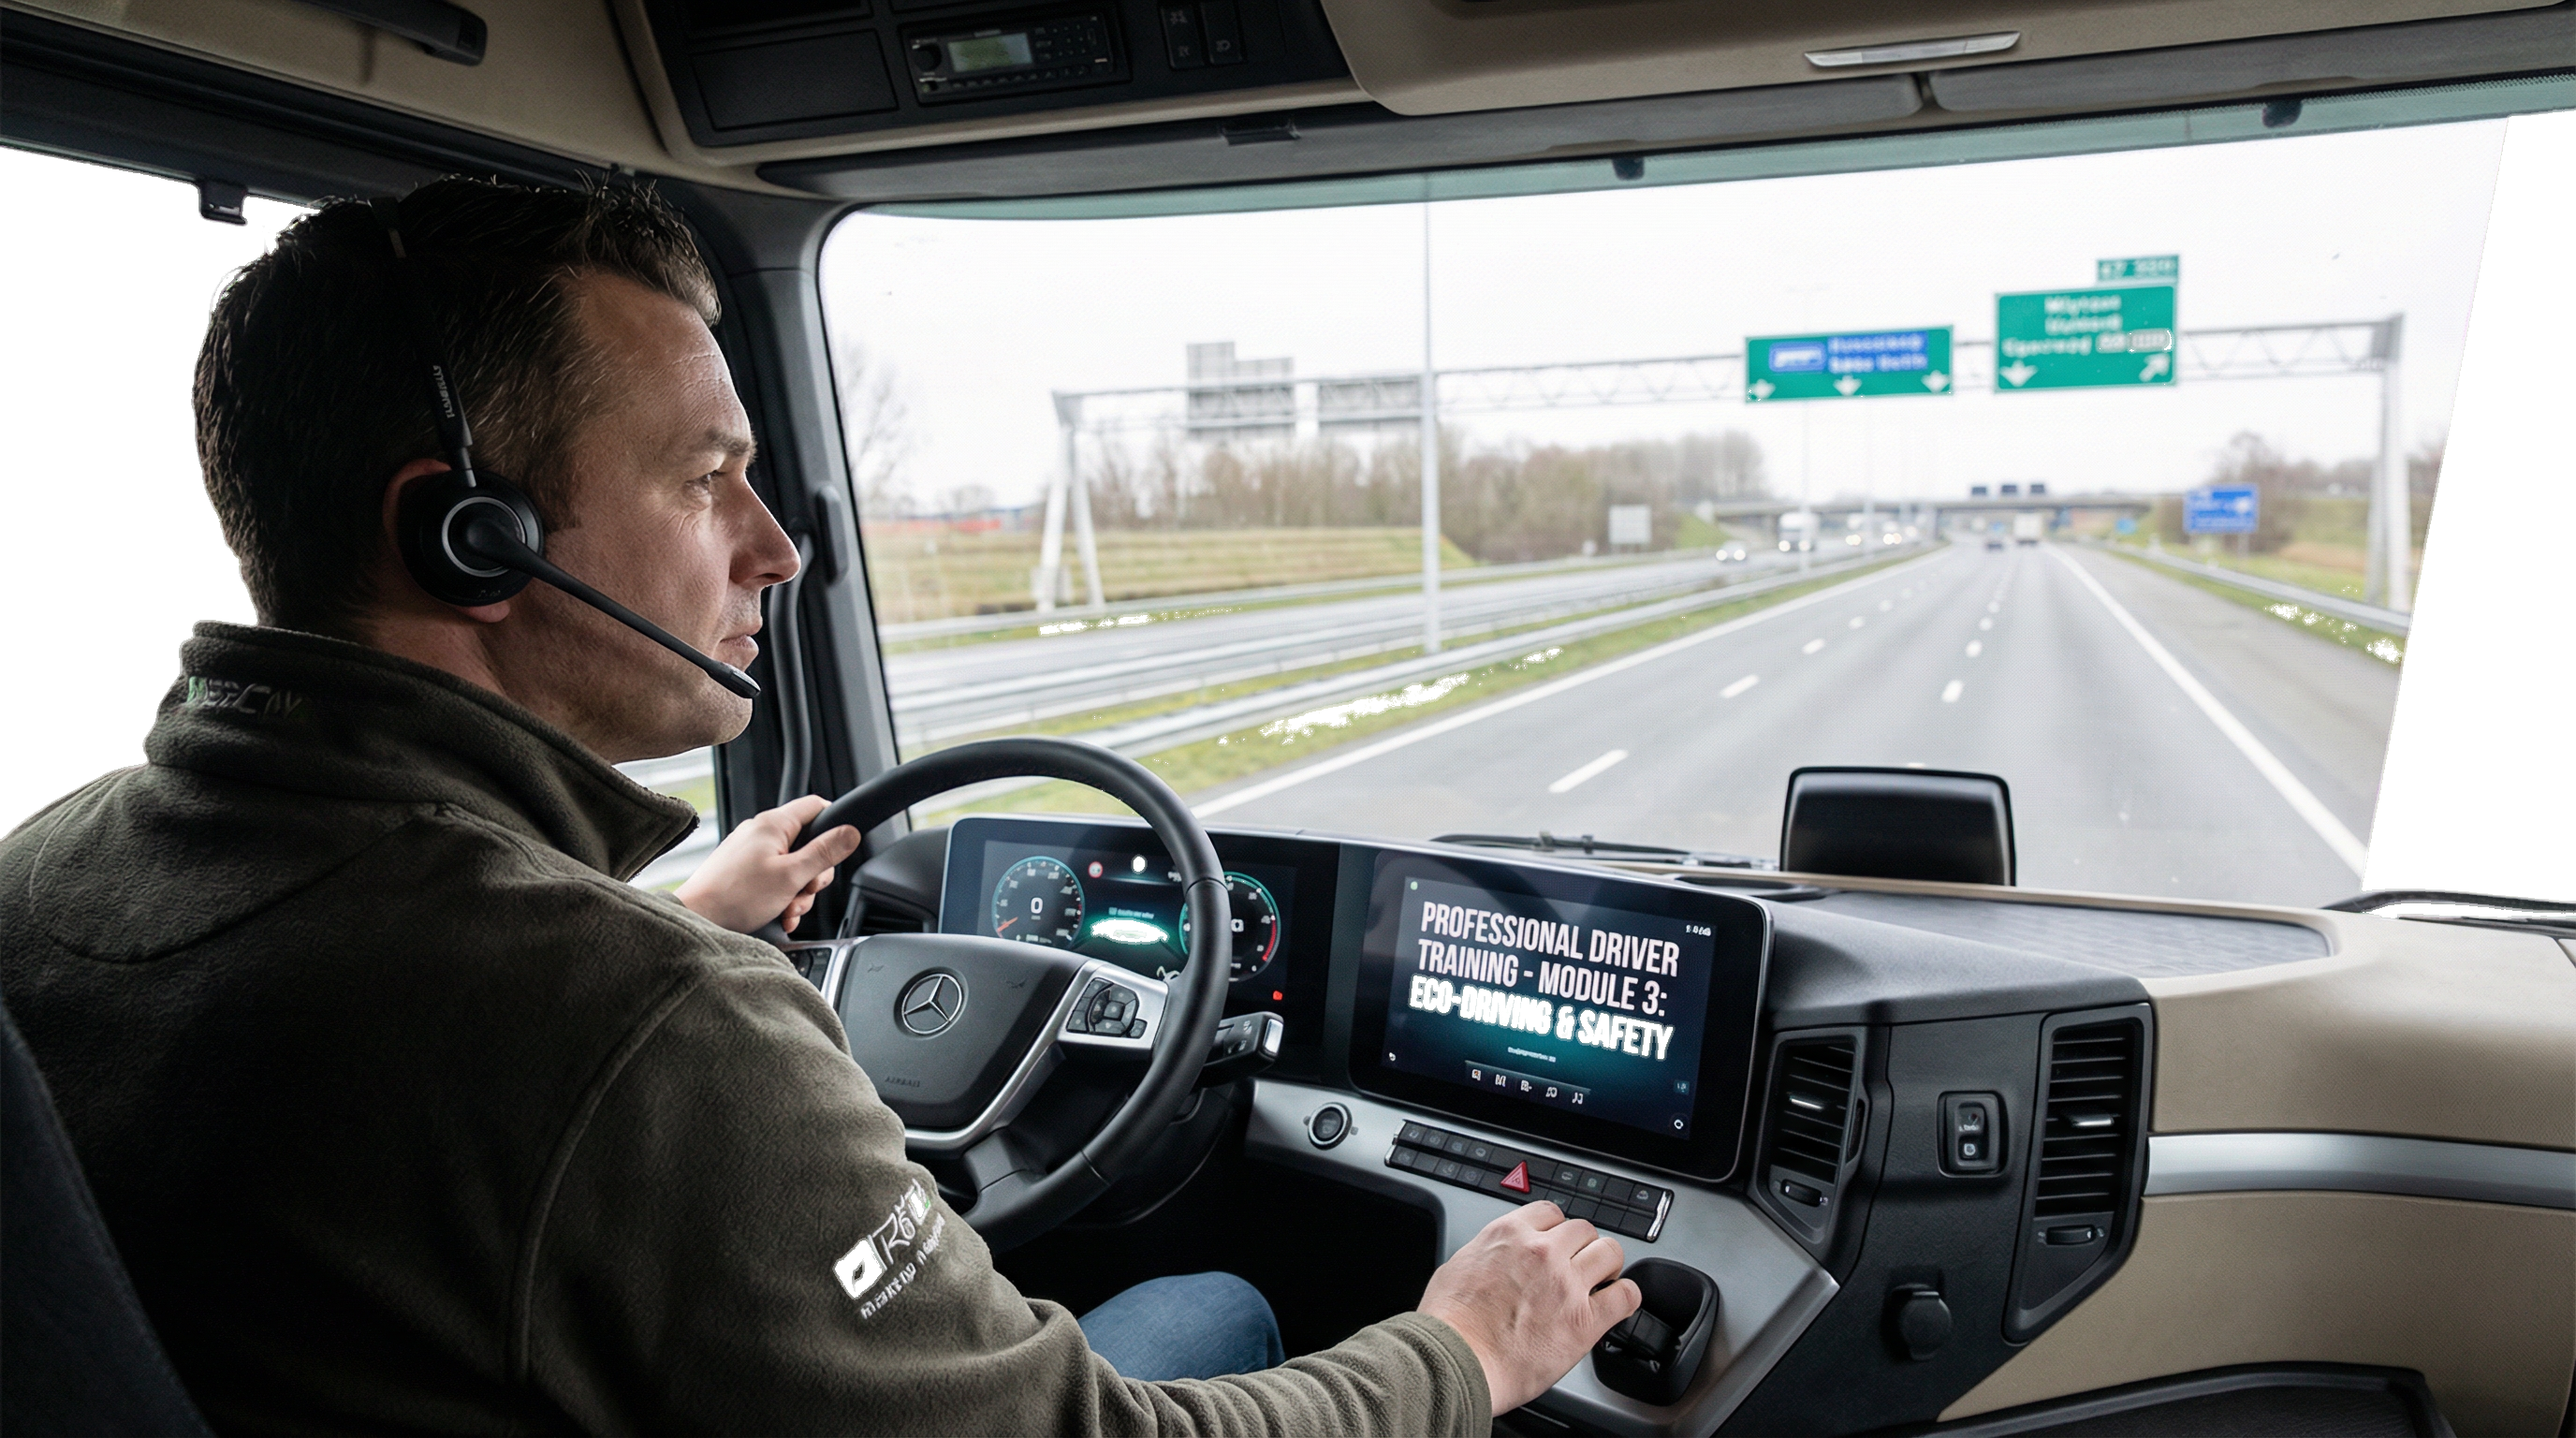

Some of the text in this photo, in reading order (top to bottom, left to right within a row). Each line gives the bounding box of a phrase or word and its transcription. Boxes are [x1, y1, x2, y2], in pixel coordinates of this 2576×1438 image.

[1031, 897, 1044, 914] 0
[1421, 901, 1680, 977] PROFESSIONAL DRIVER
[1418, 938, 1518, 988] TRAINING
[1537, 961, 1638, 1011] MODULE
[1641, 979, 1668, 1017] 3:
[1410, 976, 1674, 1060] ECO-DRIVING & SAFETY
